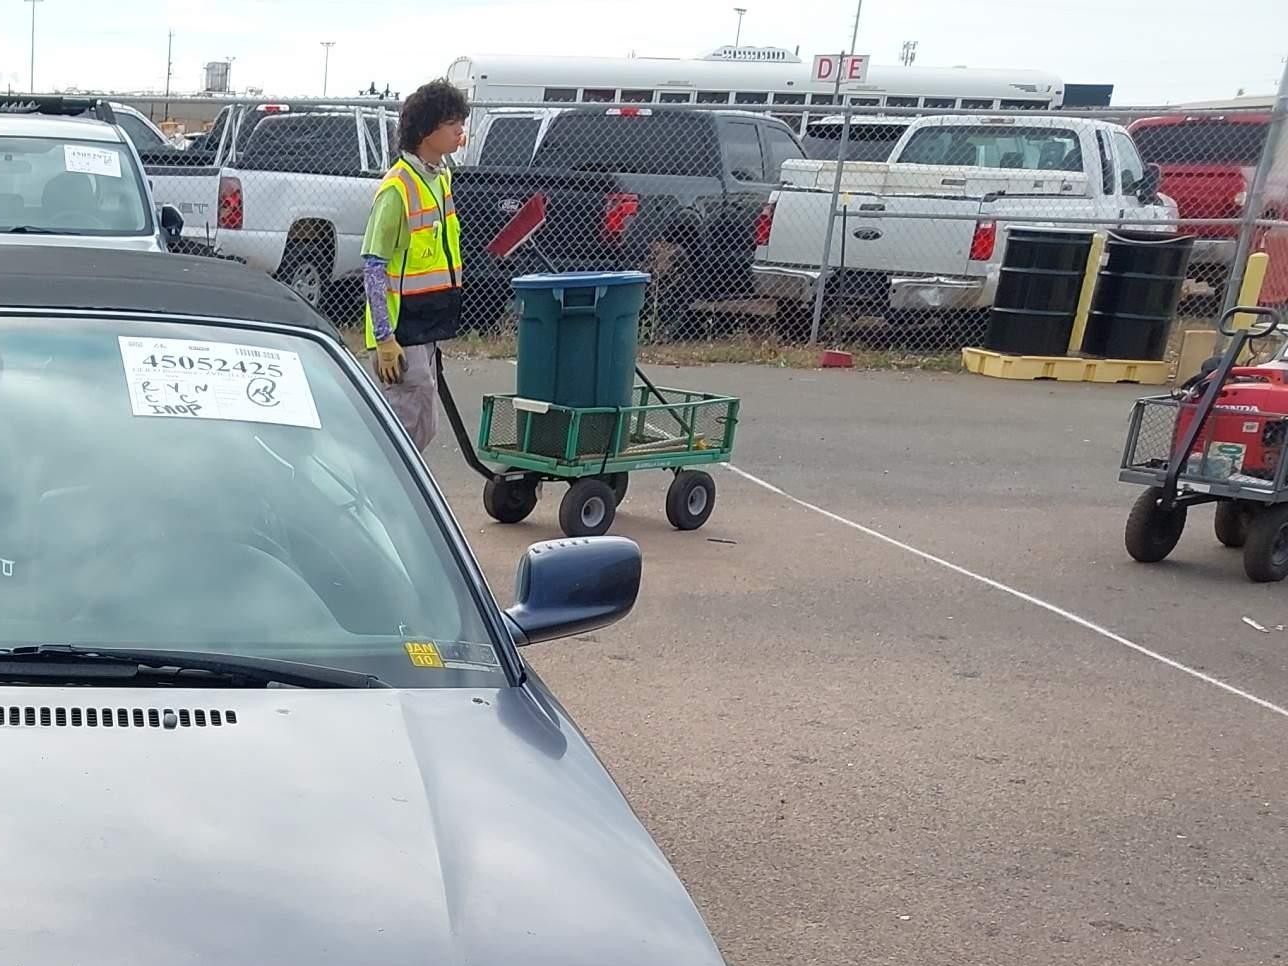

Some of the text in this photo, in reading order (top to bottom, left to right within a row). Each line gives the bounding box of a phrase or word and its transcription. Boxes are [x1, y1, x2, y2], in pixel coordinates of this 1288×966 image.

[142, 354, 283, 377] 45052425
[1215, 404, 1259, 412] ONDA
[406, 642, 433, 653] JAN
[416, 655, 433, 665] 10
